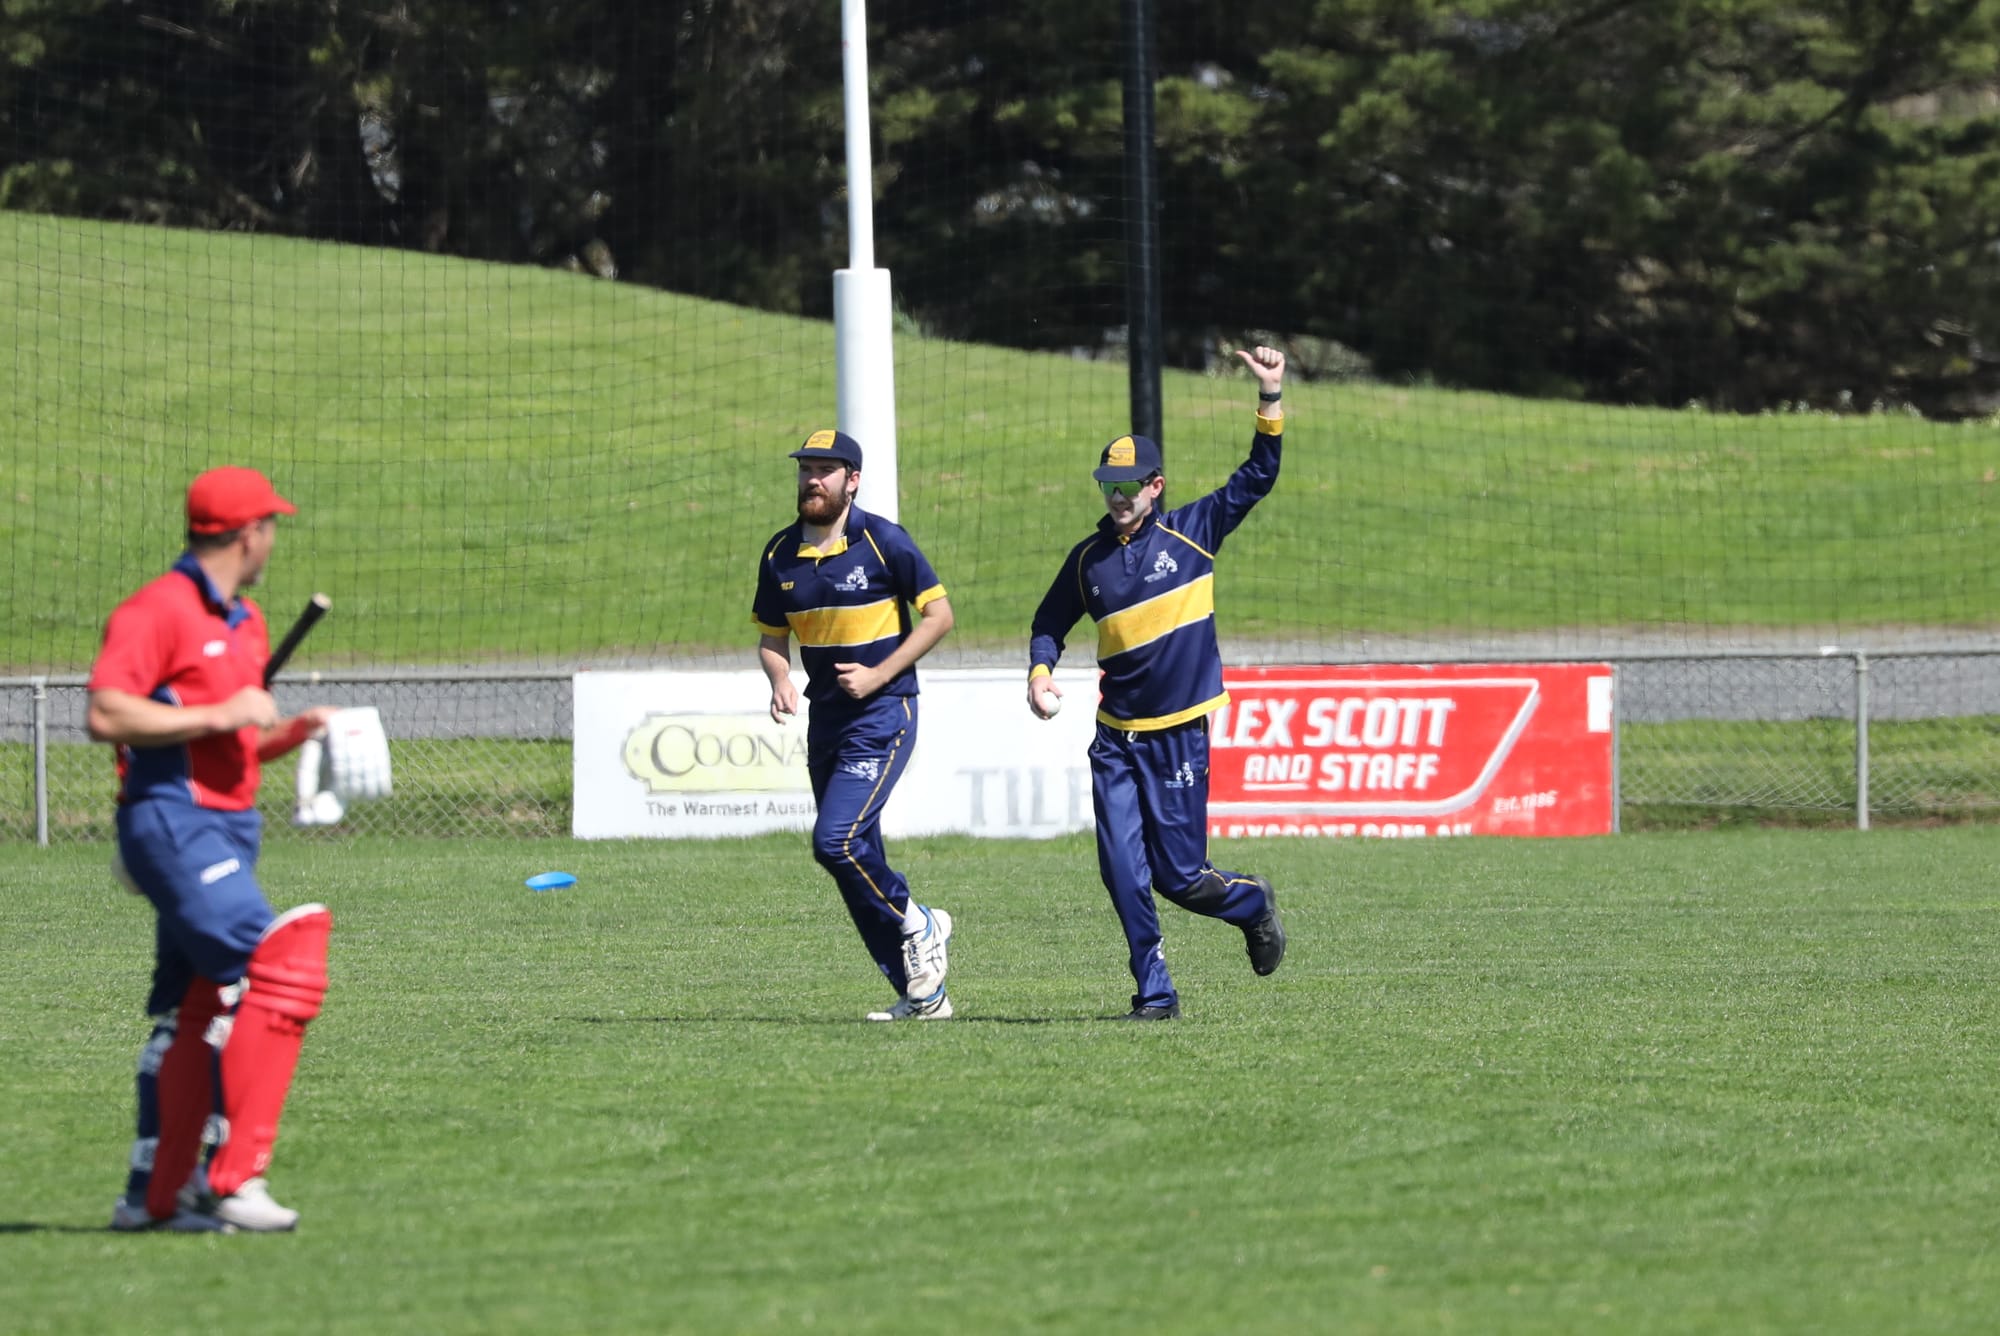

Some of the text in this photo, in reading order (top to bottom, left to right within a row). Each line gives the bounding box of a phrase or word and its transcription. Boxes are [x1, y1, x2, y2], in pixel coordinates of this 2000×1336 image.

[1207, 697, 1457, 749] LEX SCOTT
[1243, 753, 1440, 791] AND STAFF
[647, 801, 677, 816] The
[683, 801, 758, 816] Warmest
